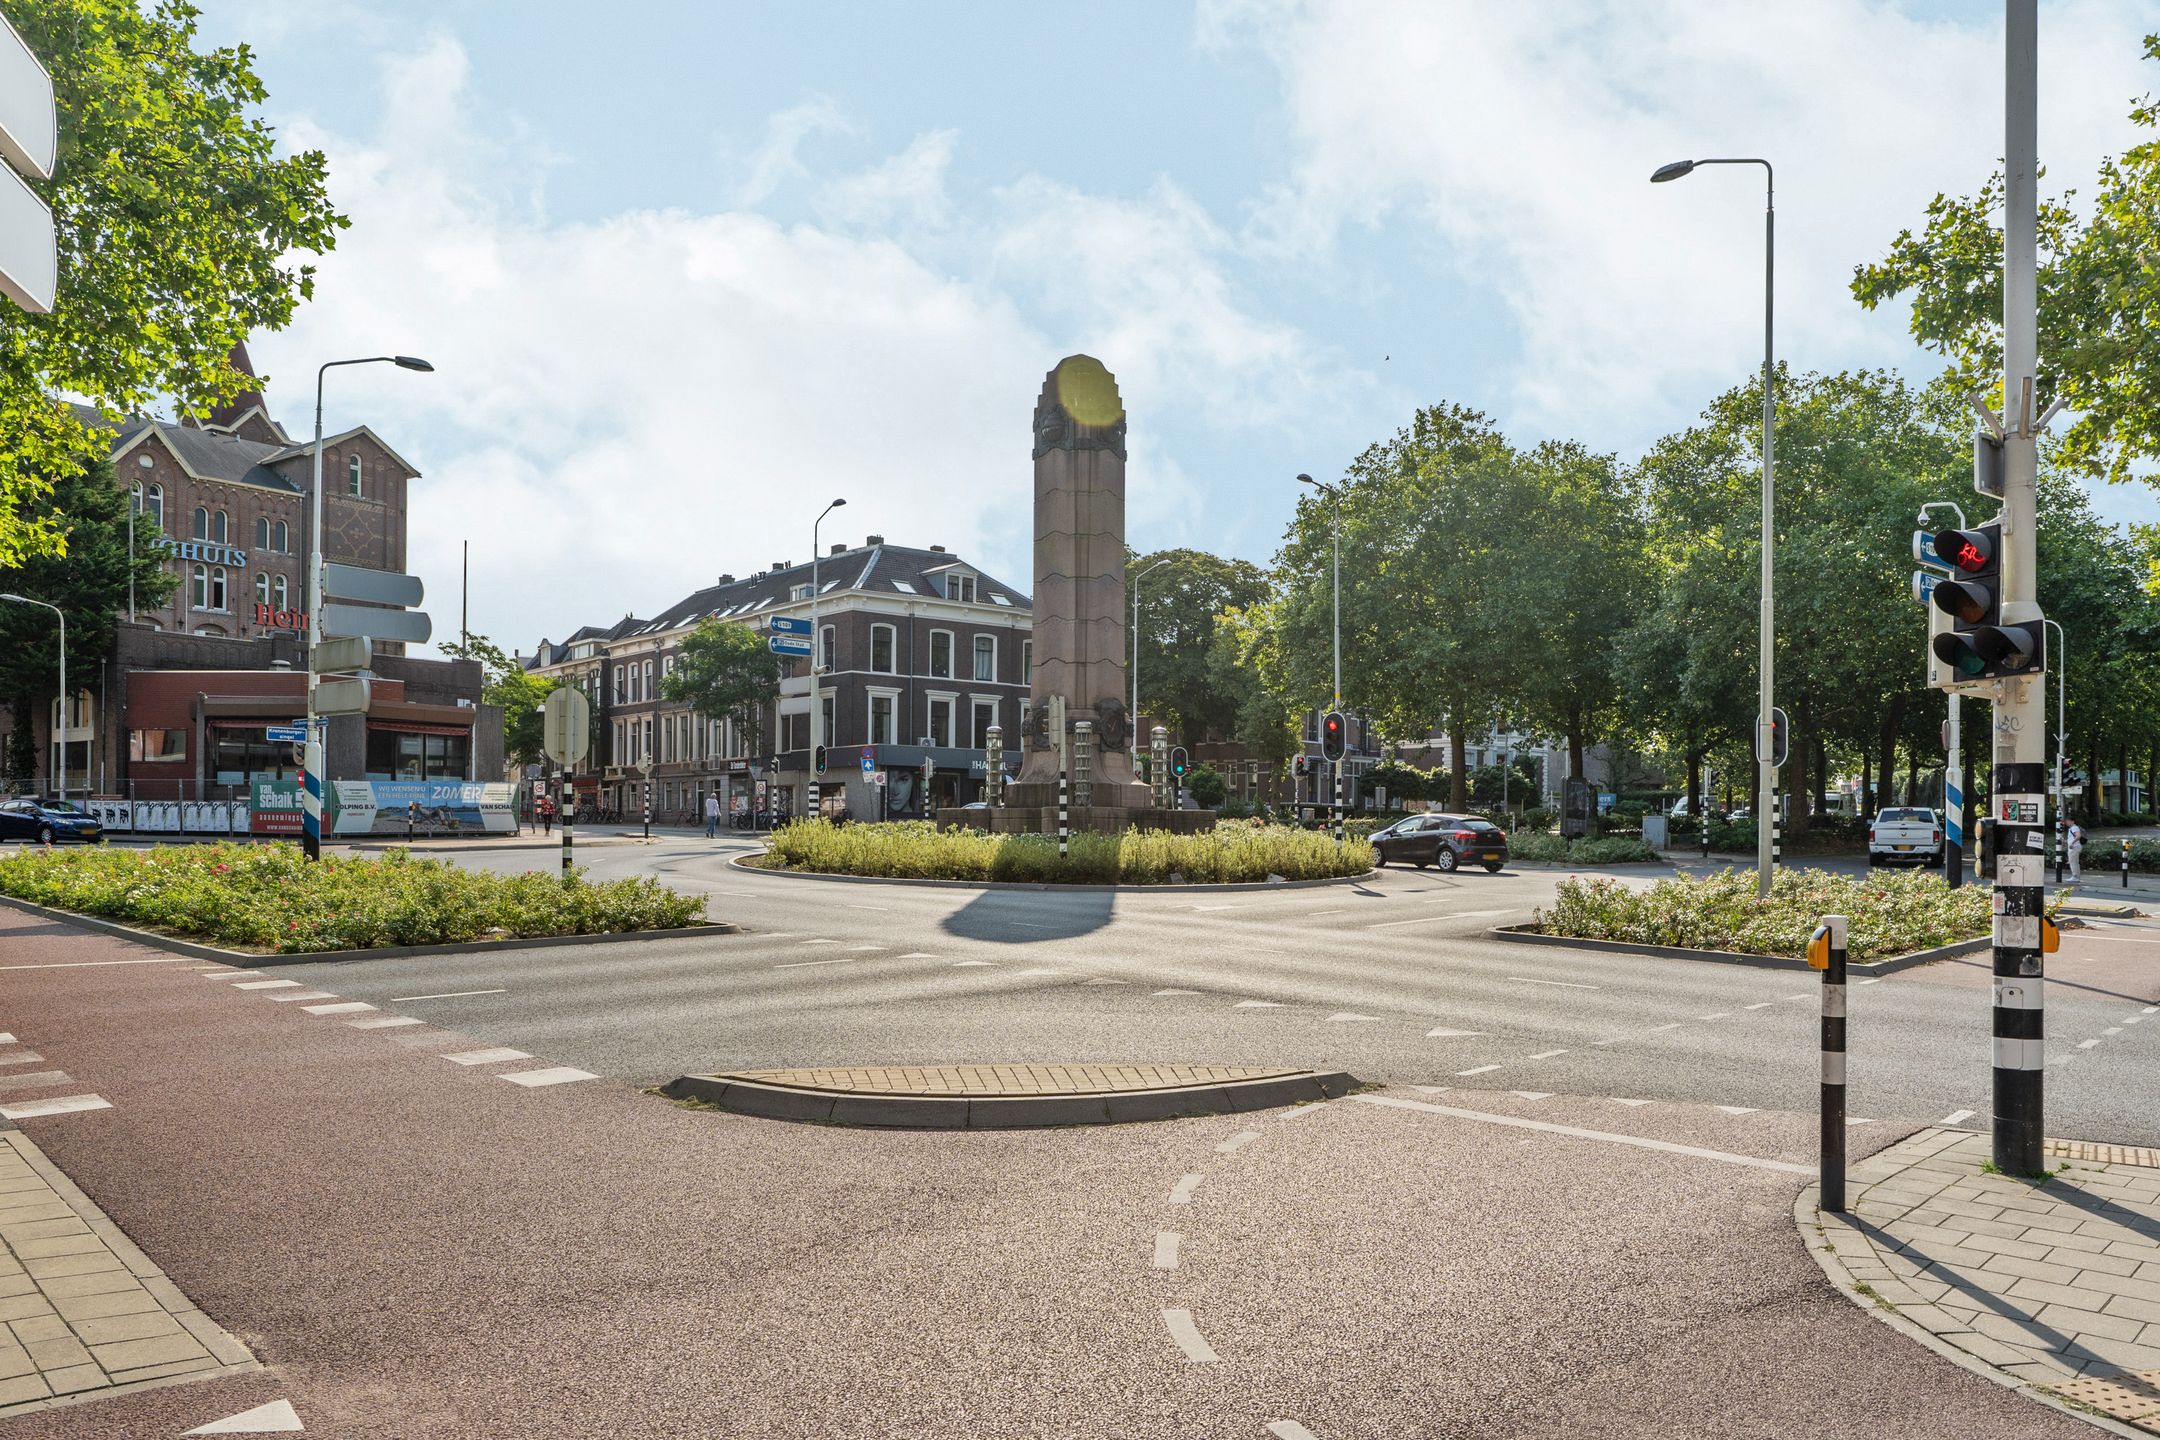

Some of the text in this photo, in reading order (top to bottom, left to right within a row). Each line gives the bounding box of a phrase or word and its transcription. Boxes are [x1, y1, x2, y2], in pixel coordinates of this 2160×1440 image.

[259, 784, 272, 795] van
[432, 785, 481, 800] ZOMER
[260, 792, 293, 808] schaik
